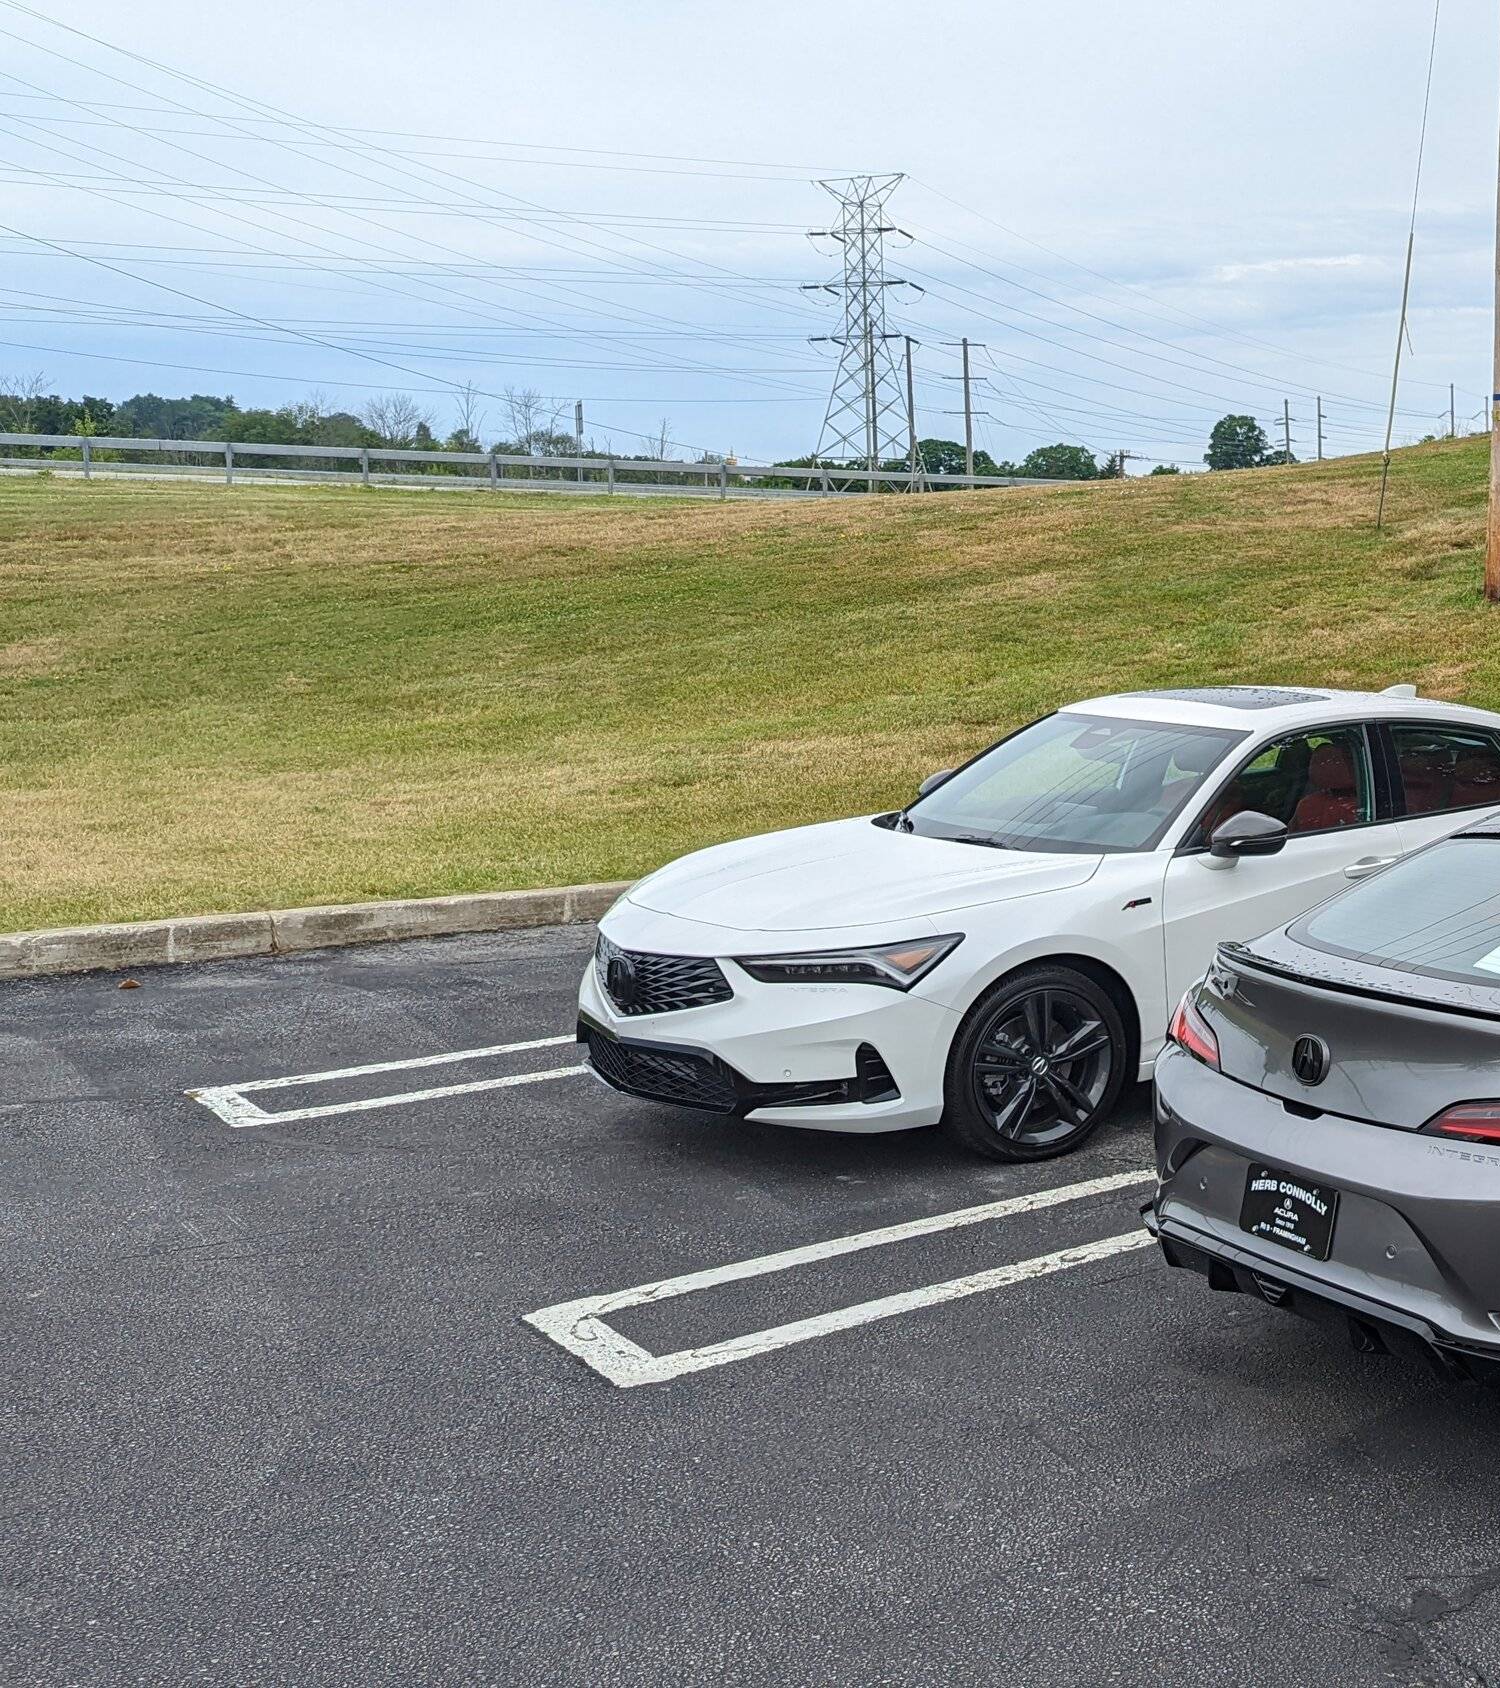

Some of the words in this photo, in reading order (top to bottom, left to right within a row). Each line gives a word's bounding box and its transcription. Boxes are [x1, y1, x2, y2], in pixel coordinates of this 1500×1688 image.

[1250, 1180, 1278, 1192] HERB
[1279, 1181, 1328, 1216] CONNOLLY
[1273, 1206, 1299, 1222] ACURA
[1272, 1226, 1307, 1245] FRAMINGHAM
